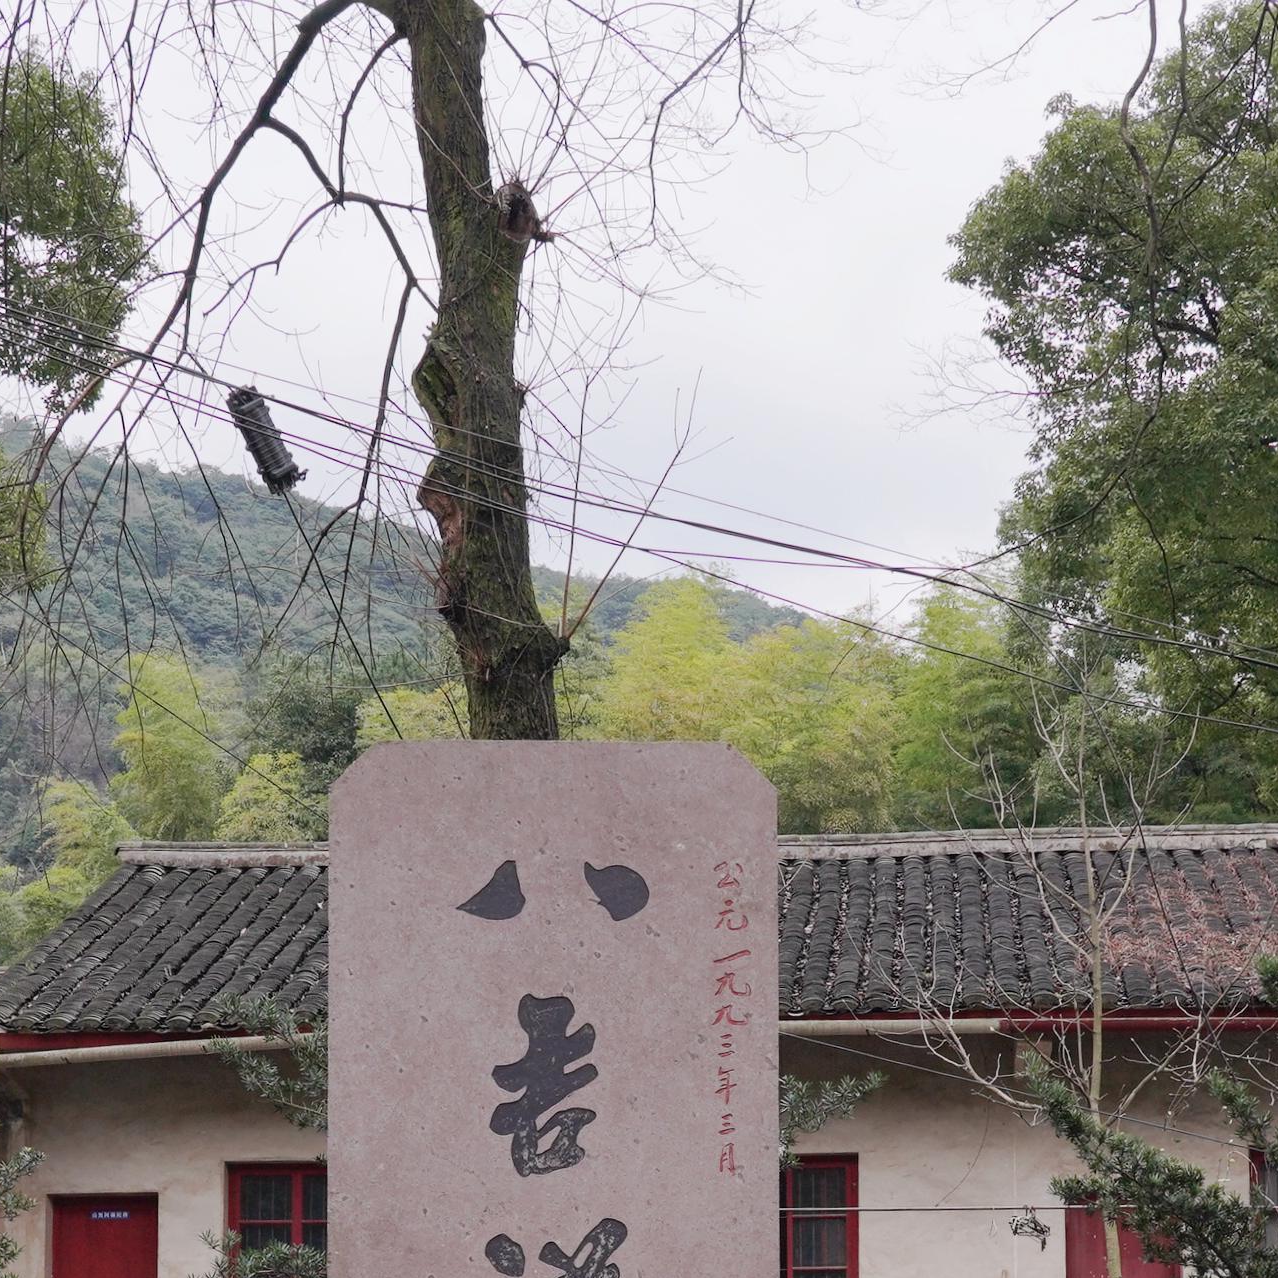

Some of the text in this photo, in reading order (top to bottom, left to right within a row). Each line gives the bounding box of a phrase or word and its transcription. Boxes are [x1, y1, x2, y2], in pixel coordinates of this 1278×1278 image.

[711, 860, 753, 1177] 公元一九九三年三月
